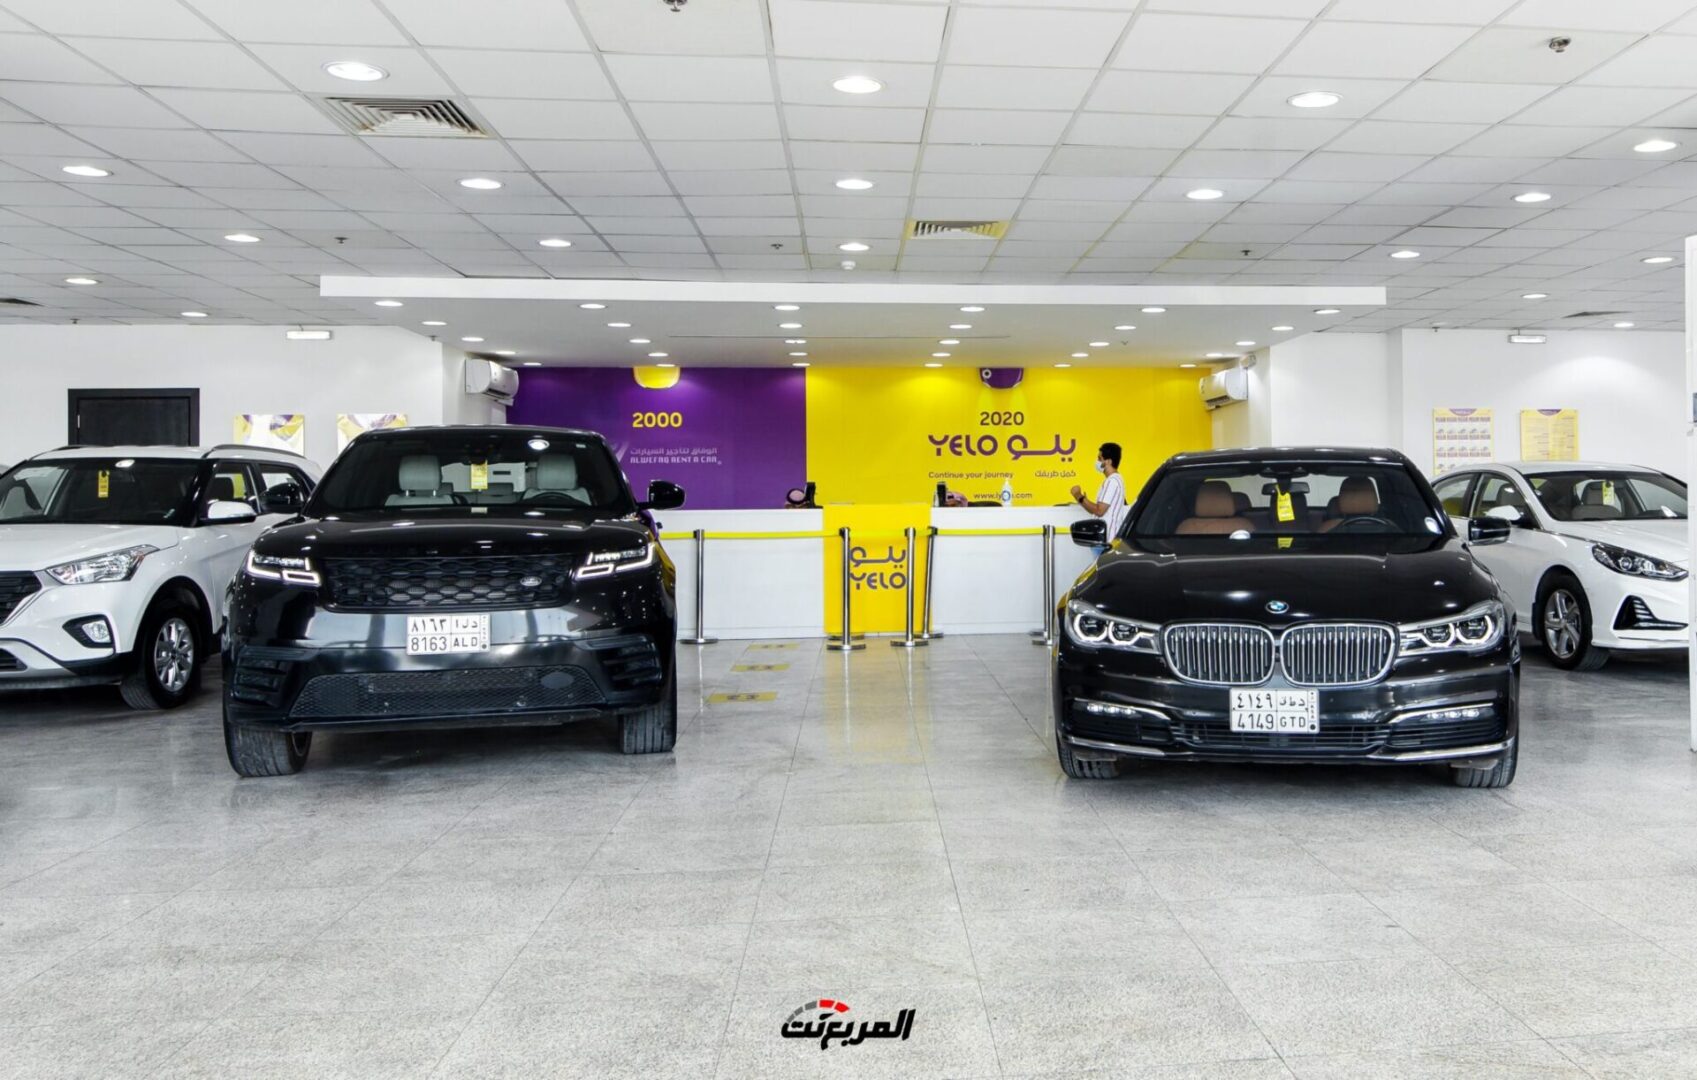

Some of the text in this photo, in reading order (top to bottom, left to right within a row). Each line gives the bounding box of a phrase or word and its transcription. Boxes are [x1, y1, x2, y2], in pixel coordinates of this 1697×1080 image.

[632, 412, 682, 428] 2000
[980, 411, 1024, 426] 2020
[928, 434, 998, 456] YELO
[928, 471, 965, 479] Continue
[984, 471, 1013, 479] journey
[850, 572, 906, 590] YELO
[411, 636, 478, 652] 8163 ALD
[1237, 713, 1306, 730] 4149 GTD
